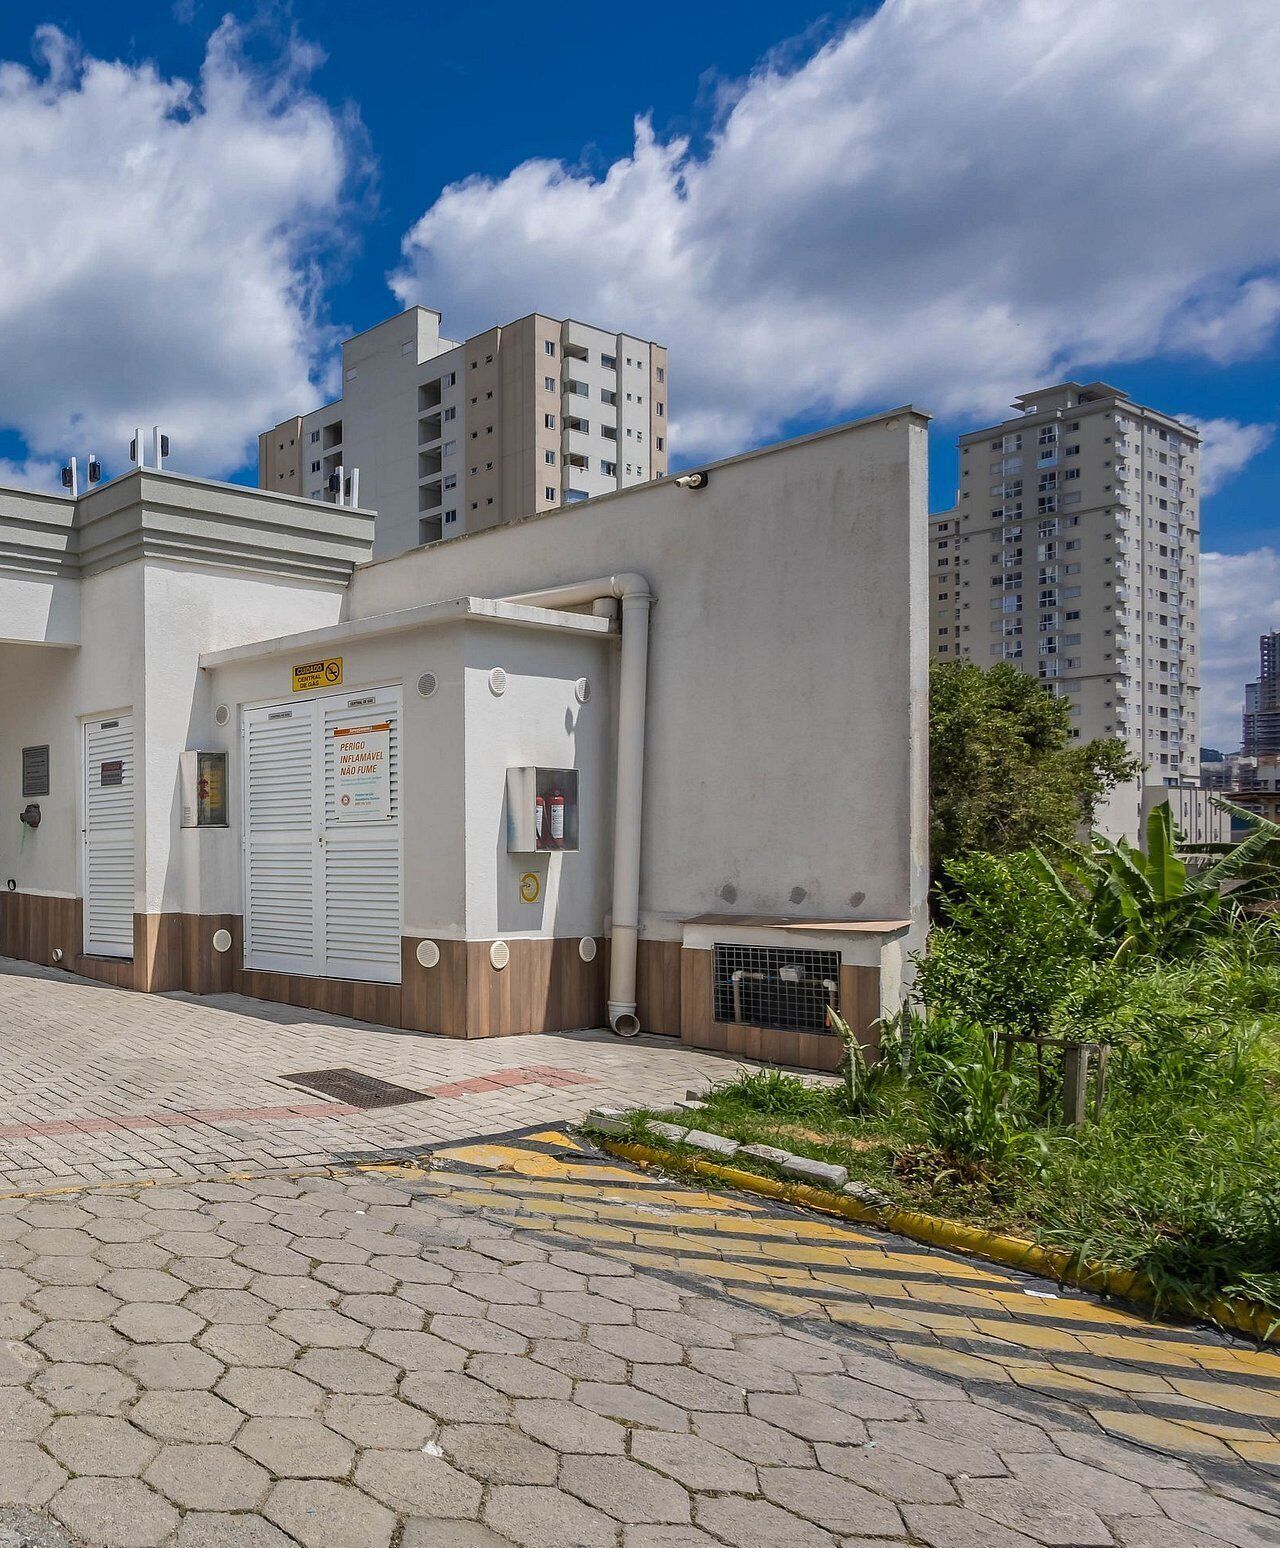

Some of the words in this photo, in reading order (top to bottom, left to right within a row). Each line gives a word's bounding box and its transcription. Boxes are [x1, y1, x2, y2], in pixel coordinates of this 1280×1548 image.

[296, 664, 323, 675] CUIDADO
[298, 674, 322, 683] CENTRAL
[340, 741, 366, 752] PERIGO
[340, 750, 384, 764] INFLAMÁVEL
[340, 765, 356, 776] NÃO
[357, 764, 377, 775] FUME
